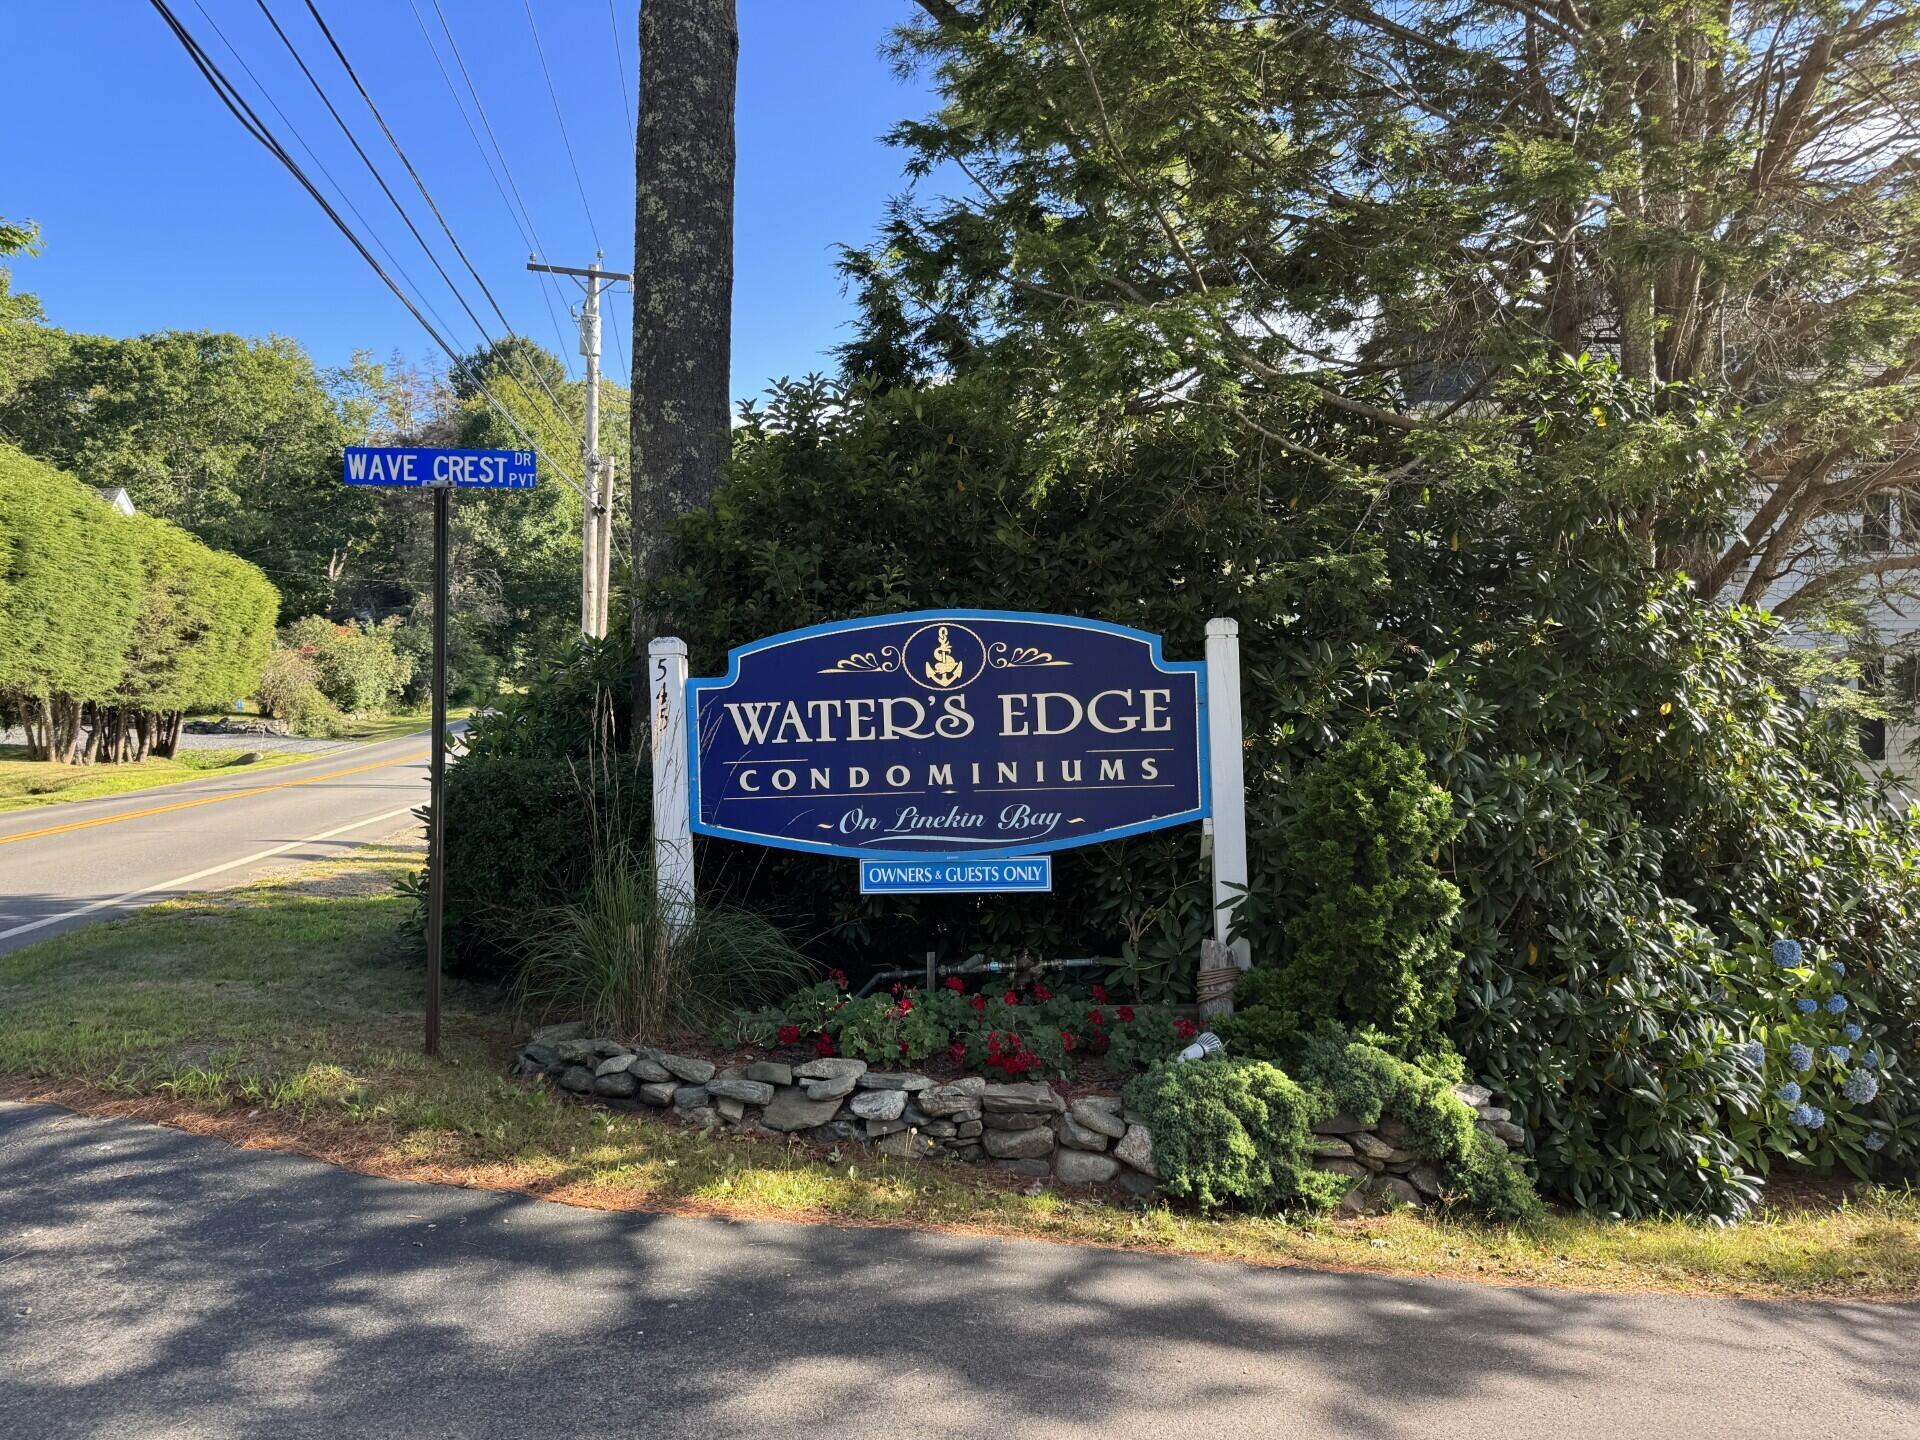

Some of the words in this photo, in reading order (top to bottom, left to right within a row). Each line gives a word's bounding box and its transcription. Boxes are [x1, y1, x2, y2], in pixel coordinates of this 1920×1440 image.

[347, 453, 418, 482] WAVE
[433, 455, 508, 484] CREST
[514, 452, 532, 467] DR
[508, 472, 536, 488] PVT
[723, 693, 975, 745] WATER'S
[997, 688, 1172, 737] EDGE
[738, 757, 1159, 792] CONDOMINIUMS
[839, 806, 880, 834] On
[884, 805, 985, 832] Linekin
[997, 803, 1062, 838] Bay
[869, 867, 932, 883] OWNERS
[935, 870, 942, 880] &
[945, 865, 999, 882] GUESTS
[1003, 865, 1042, 881] ONLY
